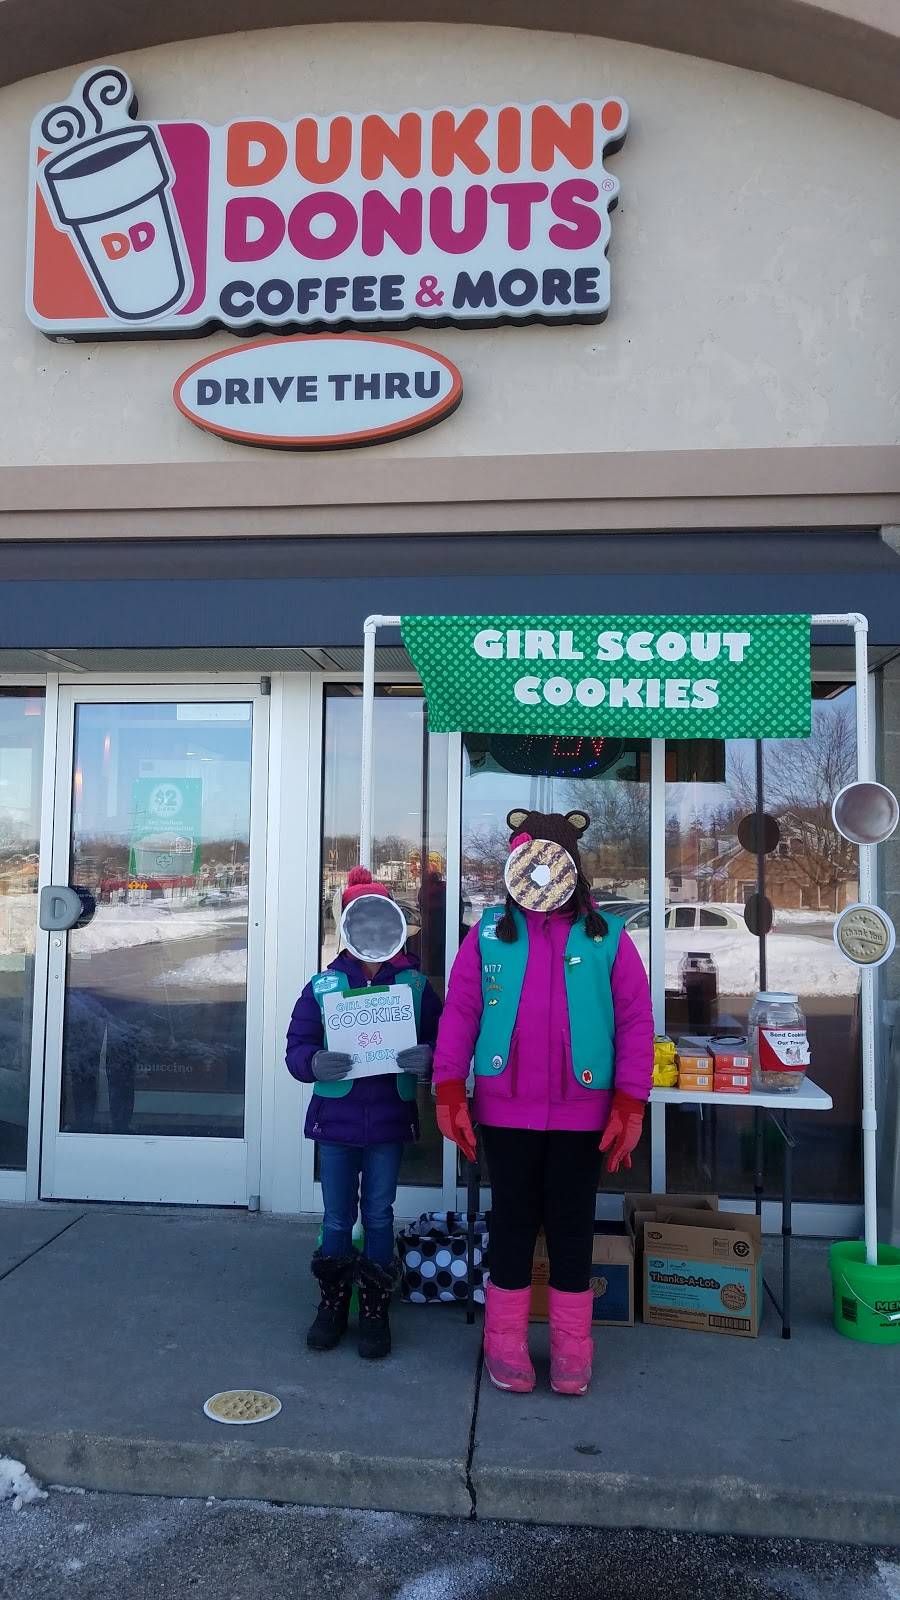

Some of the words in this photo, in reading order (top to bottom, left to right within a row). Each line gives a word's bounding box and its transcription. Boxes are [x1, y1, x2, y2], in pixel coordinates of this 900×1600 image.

[227, 101, 622, 188] DUNKIN'
[225, 178, 602, 262] DONUTS
[99, 221, 156, 261] DD
[219, 274, 405, 317] COFFEE
[416, 275, 445, 308] &
[453, 267, 601, 309] MORE
[197, 375, 318, 406] DRIVE
[328, 370, 441, 402] THRU
[473, 630, 584, 660] GIRL
[597, 631, 751, 662] SCOUT
[514, 676, 720, 709] COOKIES
[328, 1005, 413, 1030] COOKIES
[336, 1000, 361, 1012] GIRL
[364, 996, 401, 1009] SCOUT
[357, 1031, 383, 1048] $4
[353, 1054, 361, 1064] A
[366, 1049, 396, 1062] BOX
